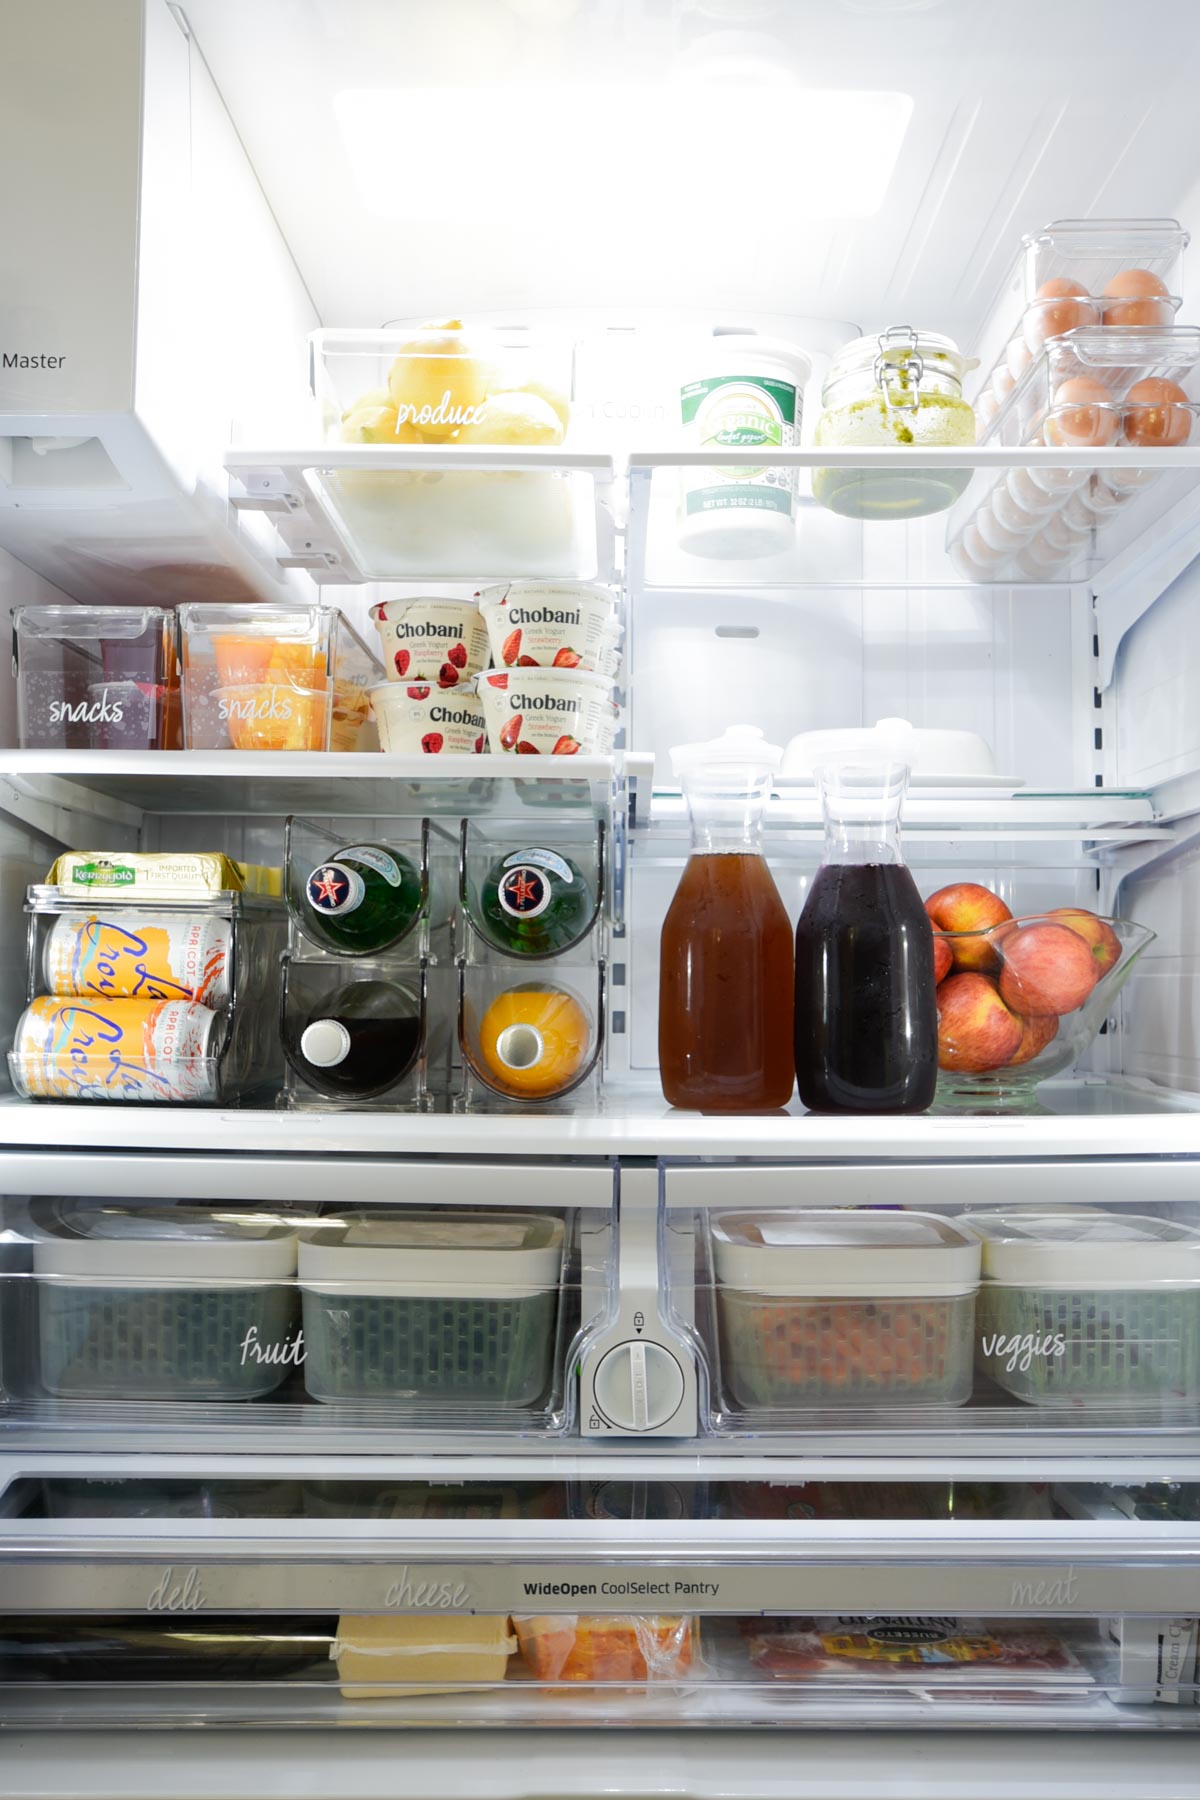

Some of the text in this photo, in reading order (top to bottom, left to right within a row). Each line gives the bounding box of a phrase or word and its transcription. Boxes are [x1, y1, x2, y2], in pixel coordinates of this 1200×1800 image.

[2, 353, 66, 369] Master
[395, 390, 487, 435] produce
[509, 607, 581, 625] Chobani
[396, 622, 464, 639] Chobani
[544, 628, 566, 637] Yogurt
[427, 641, 449, 651] Yogurt
[528, 637, 562, 645] Strawberry
[413, 650, 444, 658] Raspberry
[49, 687, 124, 723] snacks
[217, 687, 293, 720] snacks
[510, 694, 583, 713] Chobani
[525, 714, 567, 724] Greek Yogurt
[528, 724, 562, 732] Strawberry
[151, 873, 203, 881] FIRST QUALITY
[158, 865, 197, 873] IMPORTED
[186, 925, 202, 978] APRICOT
[162, 1010, 180, 1065] APRICOT
[239, 1326, 309, 1366] fruit
[982, 1329, 1066, 1373] veggies
[147, 1567, 207, 1611] deli
[384, 1564, 470, 1608] cheese
[523, 1581, 720, 1597] WideOpen CoolSelect Pantry
[1009, 1563, 1080, 1606] meat
